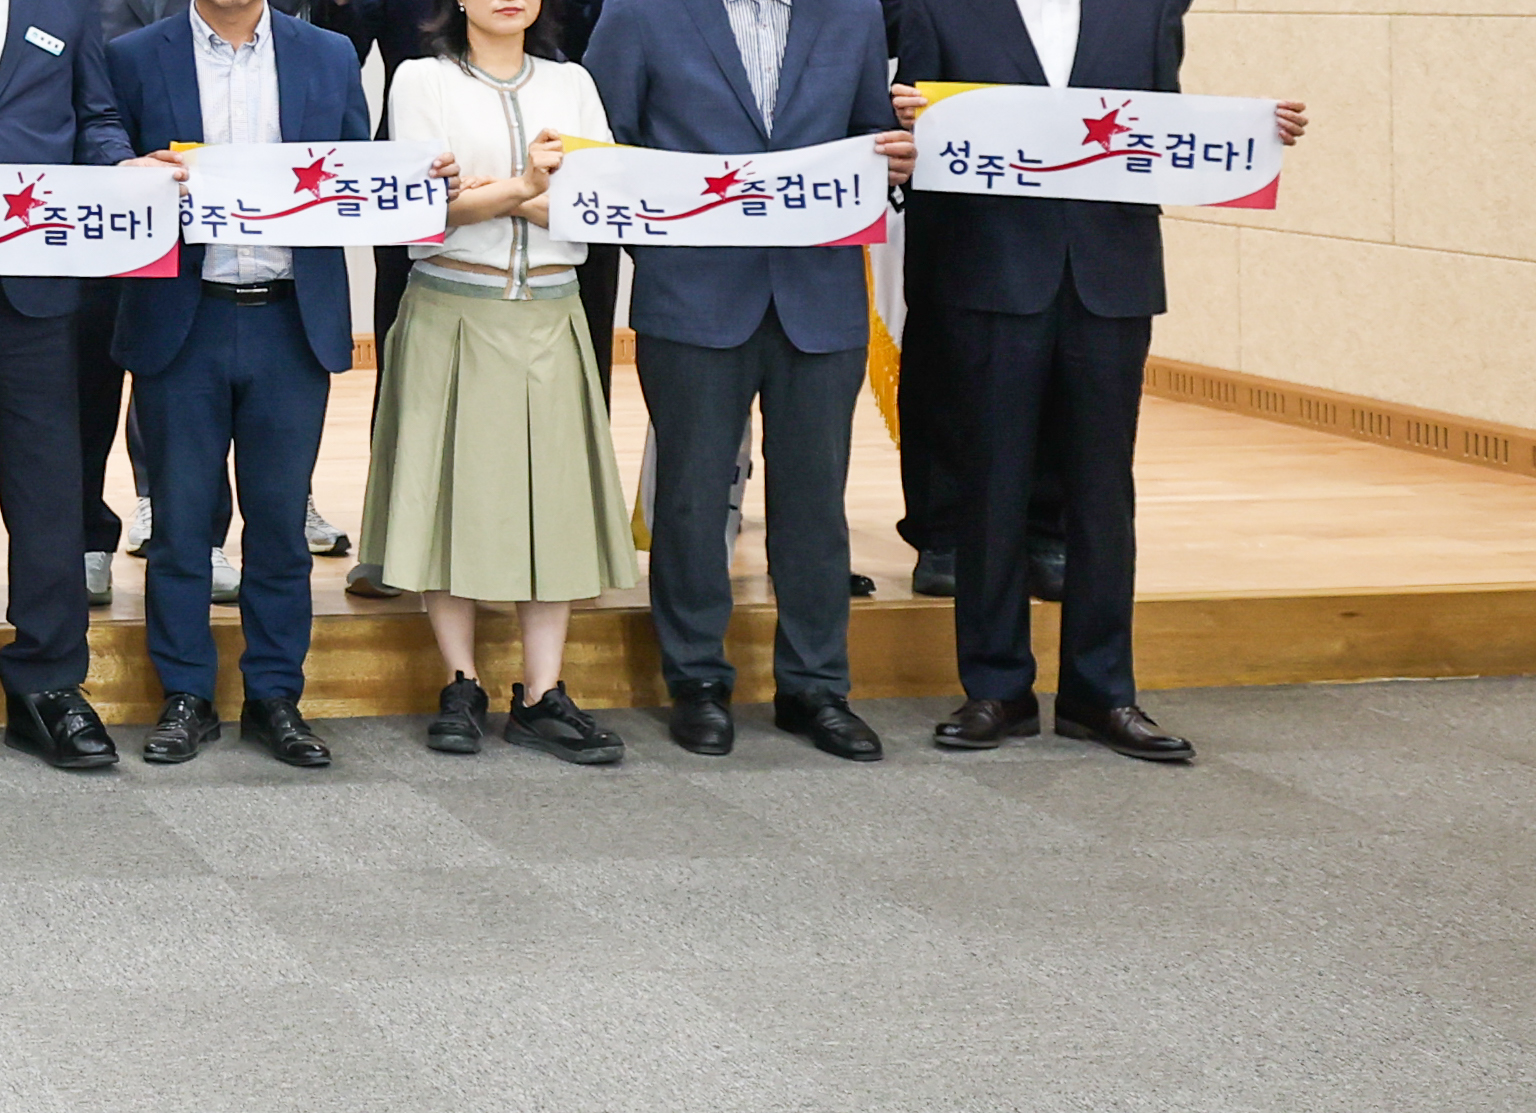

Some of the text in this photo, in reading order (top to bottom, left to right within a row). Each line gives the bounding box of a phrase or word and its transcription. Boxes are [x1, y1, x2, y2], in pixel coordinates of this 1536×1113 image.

[939, 133, 1255, 190] 성주는 즐겁다!
[43, 203, 154, 246] 즐겁다!
[572, 173, 861, 239] 성주는 즐겁다!
